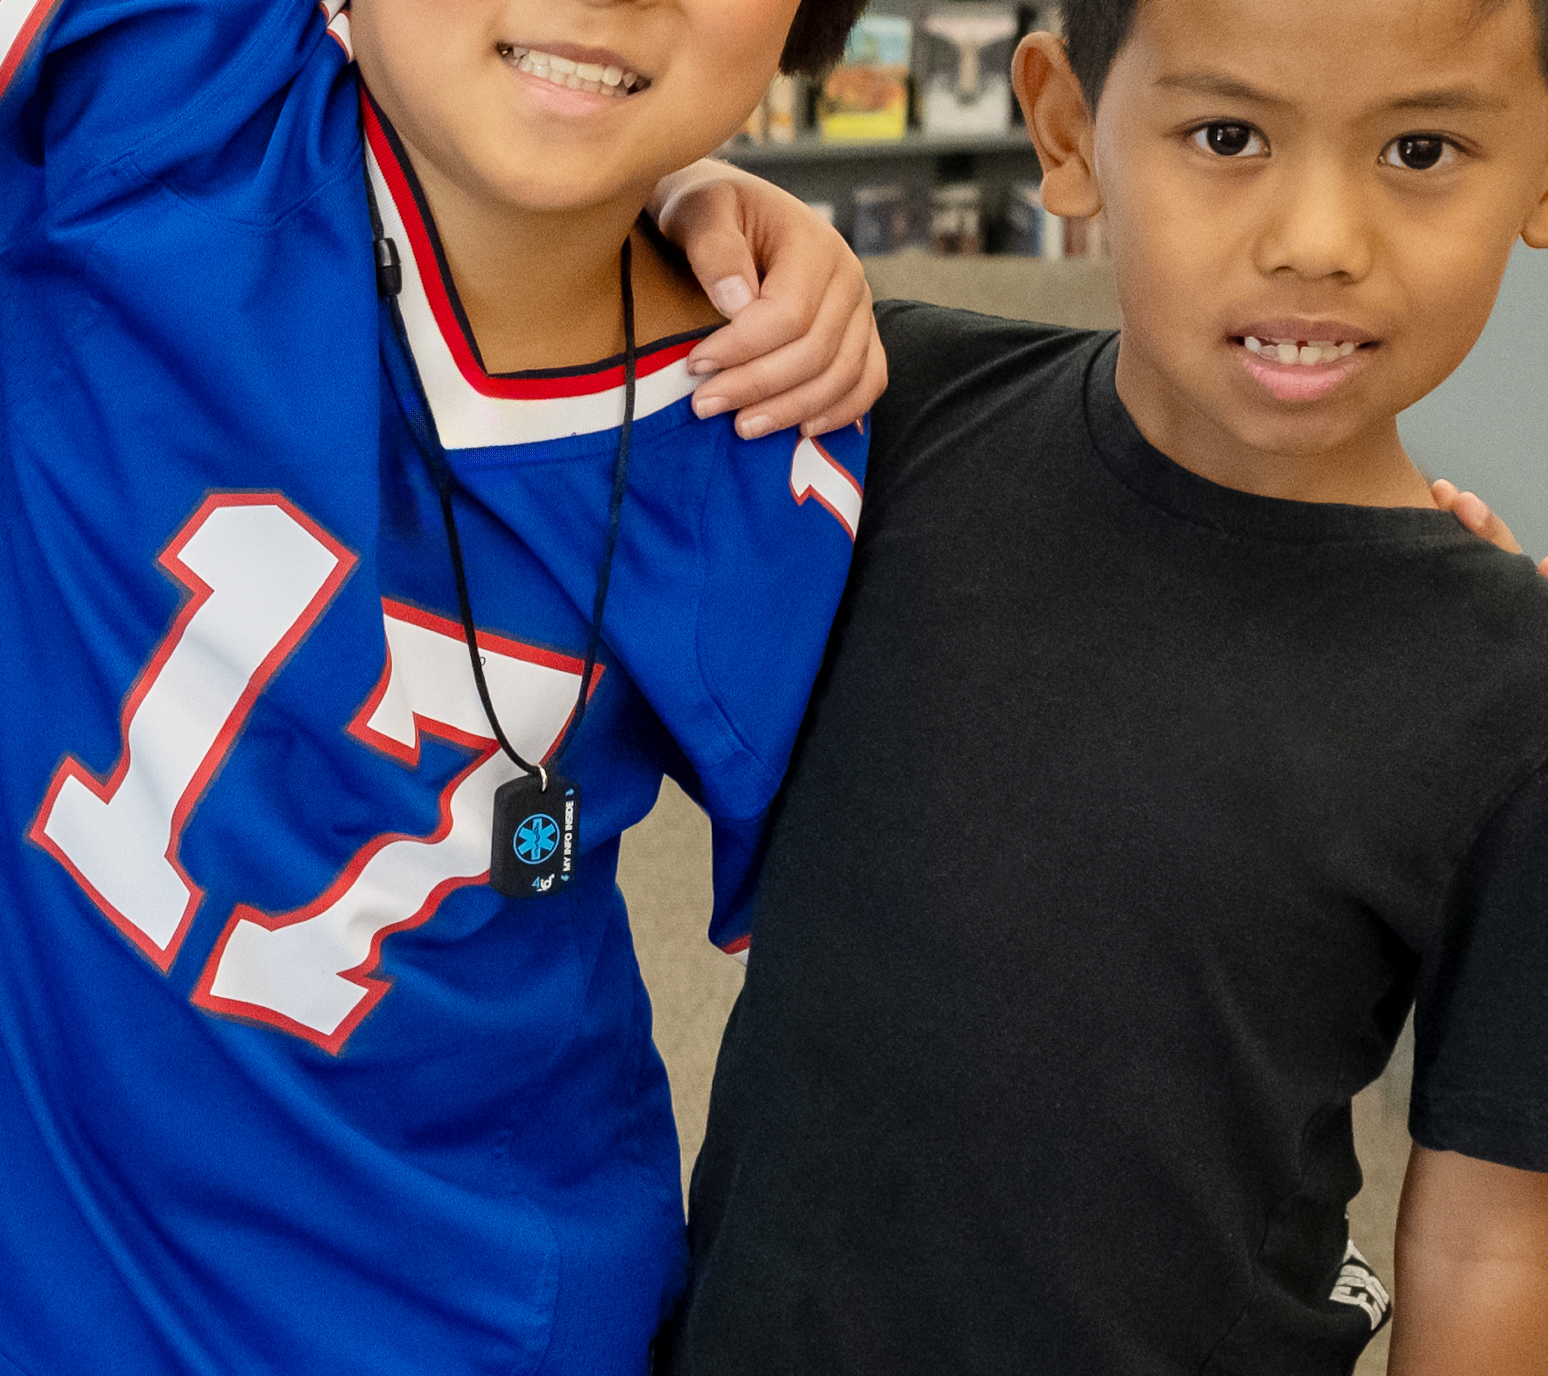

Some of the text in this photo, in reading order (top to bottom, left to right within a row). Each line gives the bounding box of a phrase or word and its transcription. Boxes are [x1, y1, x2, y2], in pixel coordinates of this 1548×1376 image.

[29, 492, 606, 1054] 17
[562, 800, 574, 872] MY INFO INSIDE
